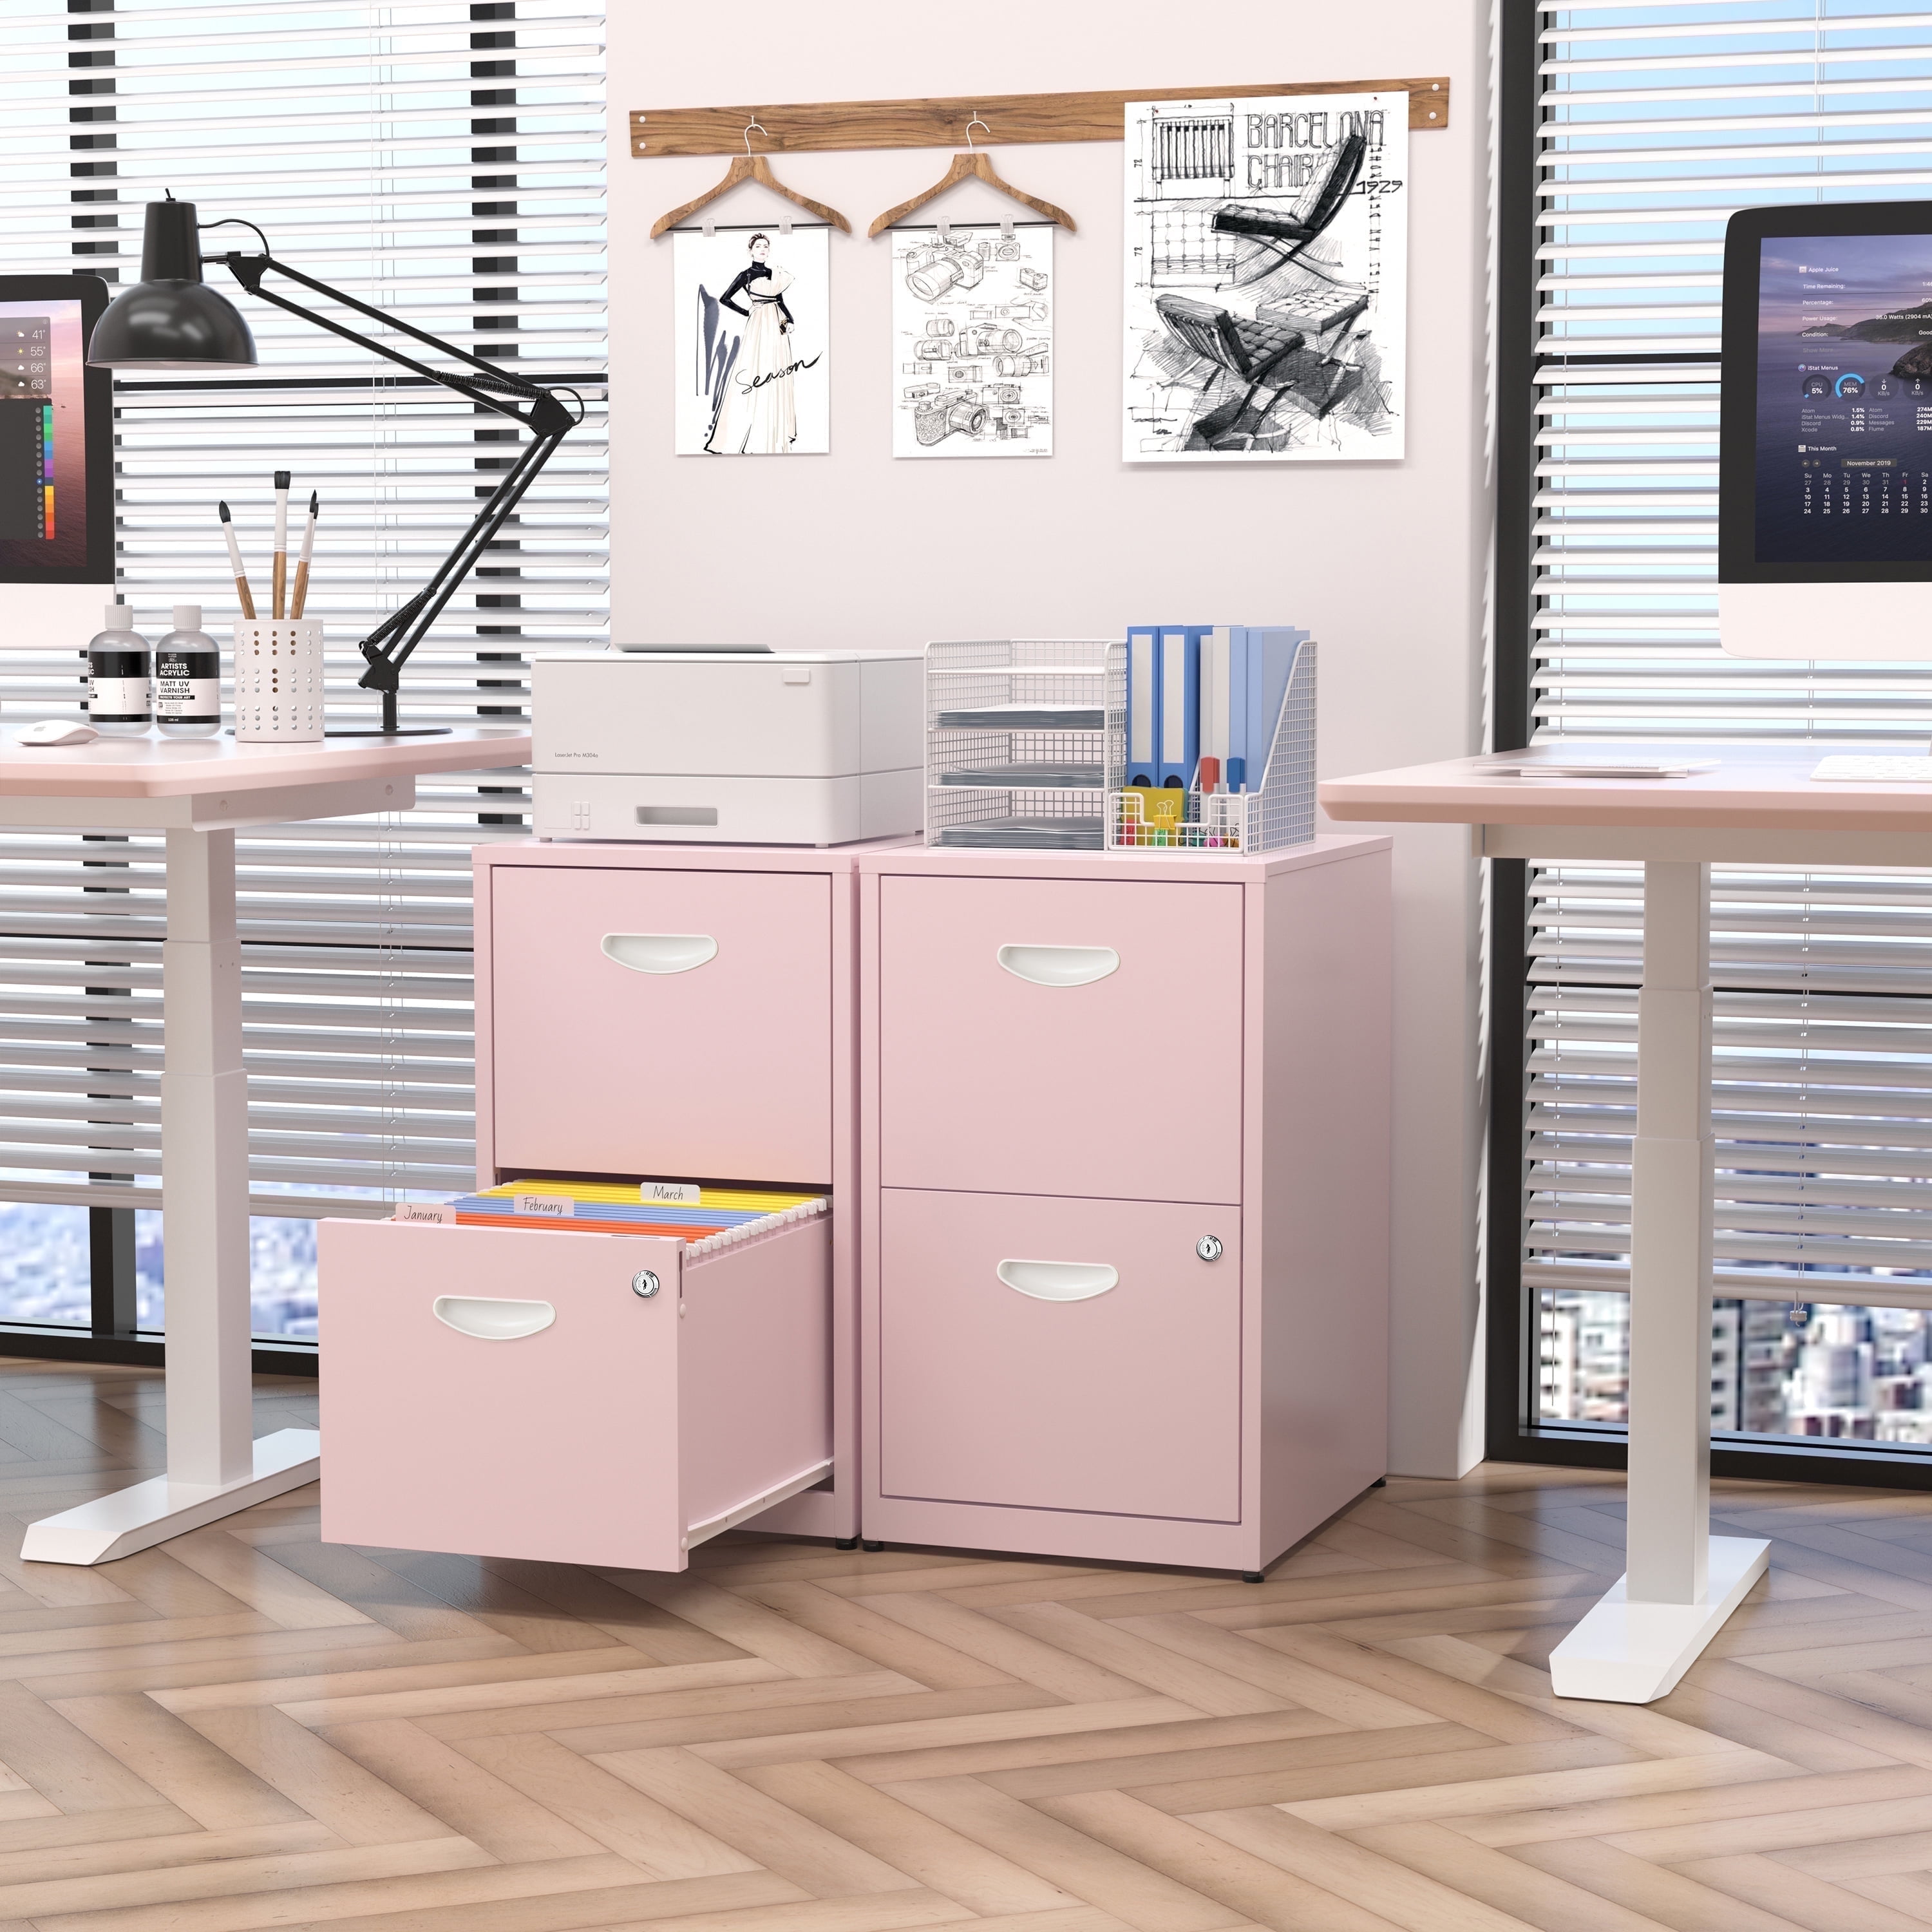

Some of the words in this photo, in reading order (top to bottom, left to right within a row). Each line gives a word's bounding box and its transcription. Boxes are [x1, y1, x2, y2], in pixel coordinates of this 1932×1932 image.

[1247, 110, 1384, 149] BARCELONA
[1247, 154, 1314, 188] CHAIR
[1356, 180, 1403, 194] 1929
[735, 351, 823, 394] Season
[653, 1185, 683, 1200] March
[404, 1206, 443, 1224] January
[523, 1197, 563, 1216] February
